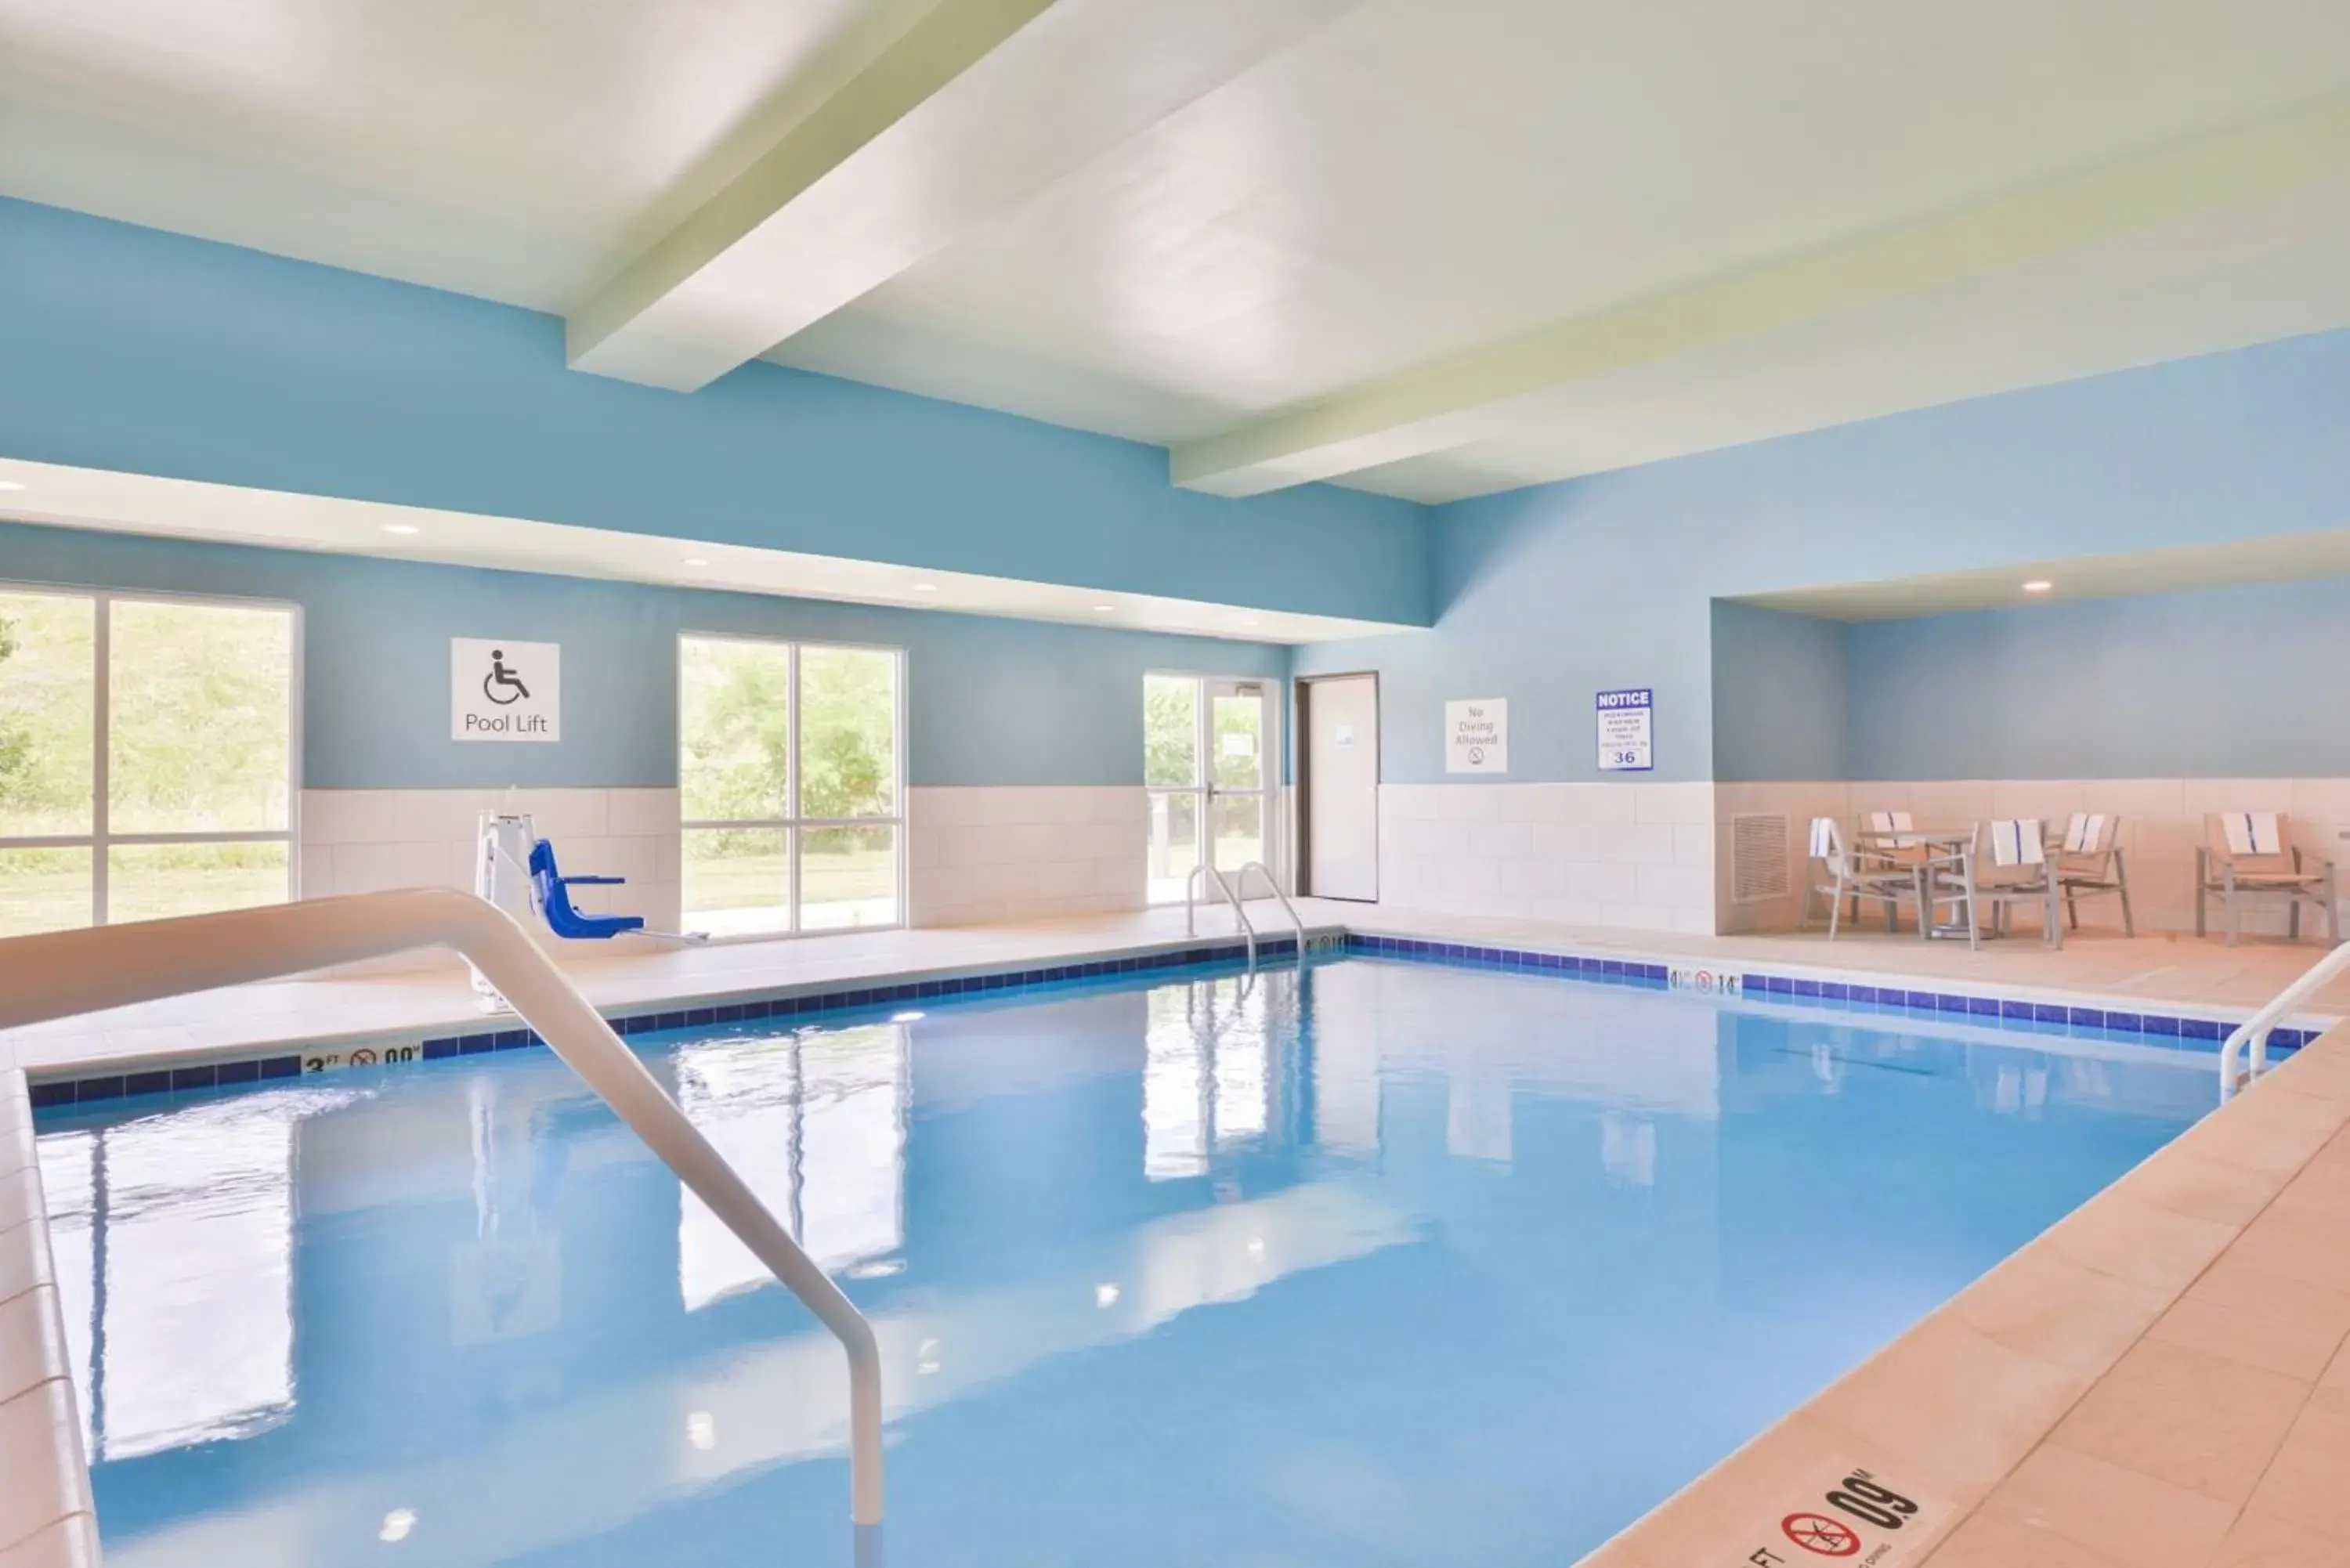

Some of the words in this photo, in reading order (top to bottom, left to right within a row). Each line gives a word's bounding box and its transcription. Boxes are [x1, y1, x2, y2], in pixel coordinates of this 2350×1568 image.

[1598, 691, 1649, 707] NOTICE
[1467, 706, 1484, 718] No
[465, 714, 509, 732] Pool
[517, 714, 548, 732] Lift
[1459, 721, 1494, 734] Diving
[1455, 733, 1498, 746] Allowed
[1614, 751, 1636, 764] 36
